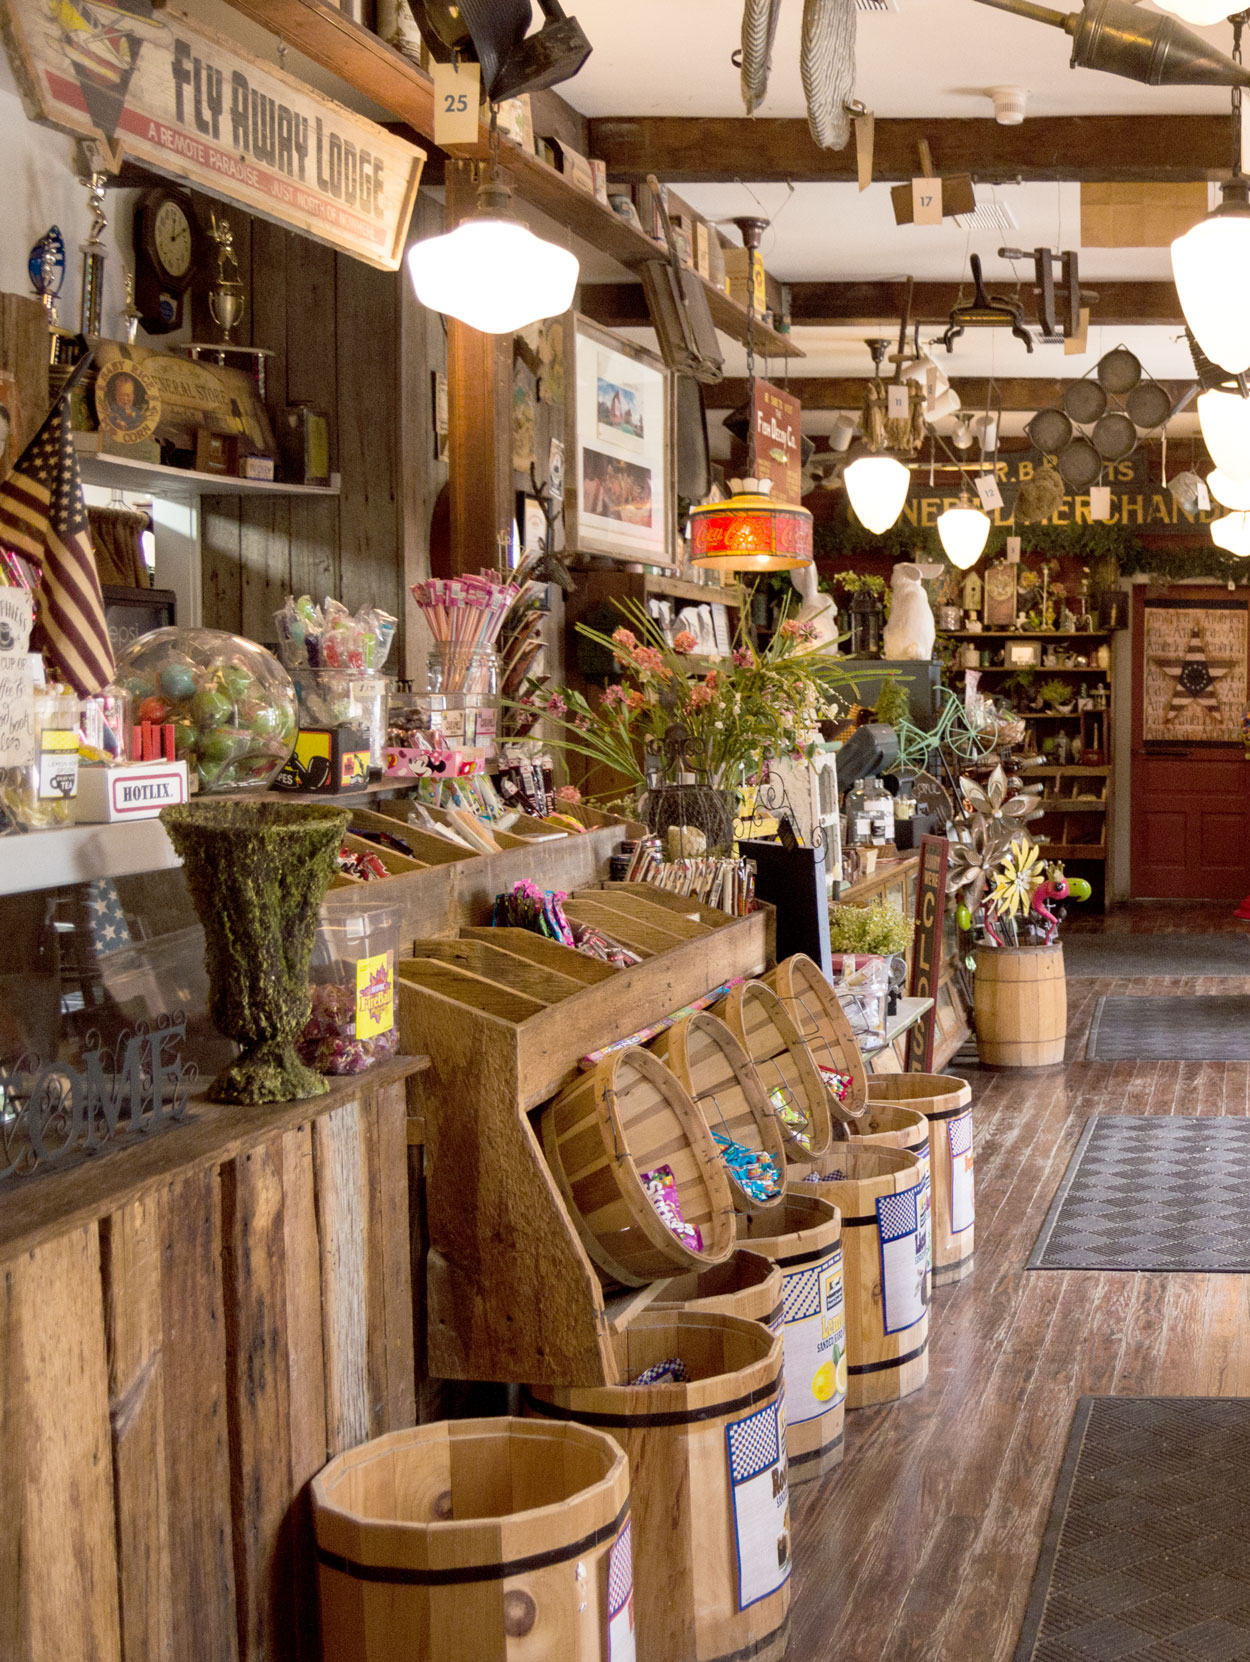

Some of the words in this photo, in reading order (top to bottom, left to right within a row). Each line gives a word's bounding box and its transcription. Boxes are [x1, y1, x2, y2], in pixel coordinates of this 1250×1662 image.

[444, 94, 468, 113] 25
[171, 39, 223, 141] FLY
[230, 69, 309, 183] AWAY
[315, 115, 384, 220] LODGE
[148, 121, 159, 140] A
[160, 126, 206, 163] REMOTE
[270, 182, 293, 201] JUST
[297, 191, 326, 221] NORTH
[326, 203, 337, 224] OF
[919, 195, 933, 208] 17
[151, 375, 193, 399] ENERAL
[984, 489, 995, 498] 12
[108, 622, 139, 647] epsi
